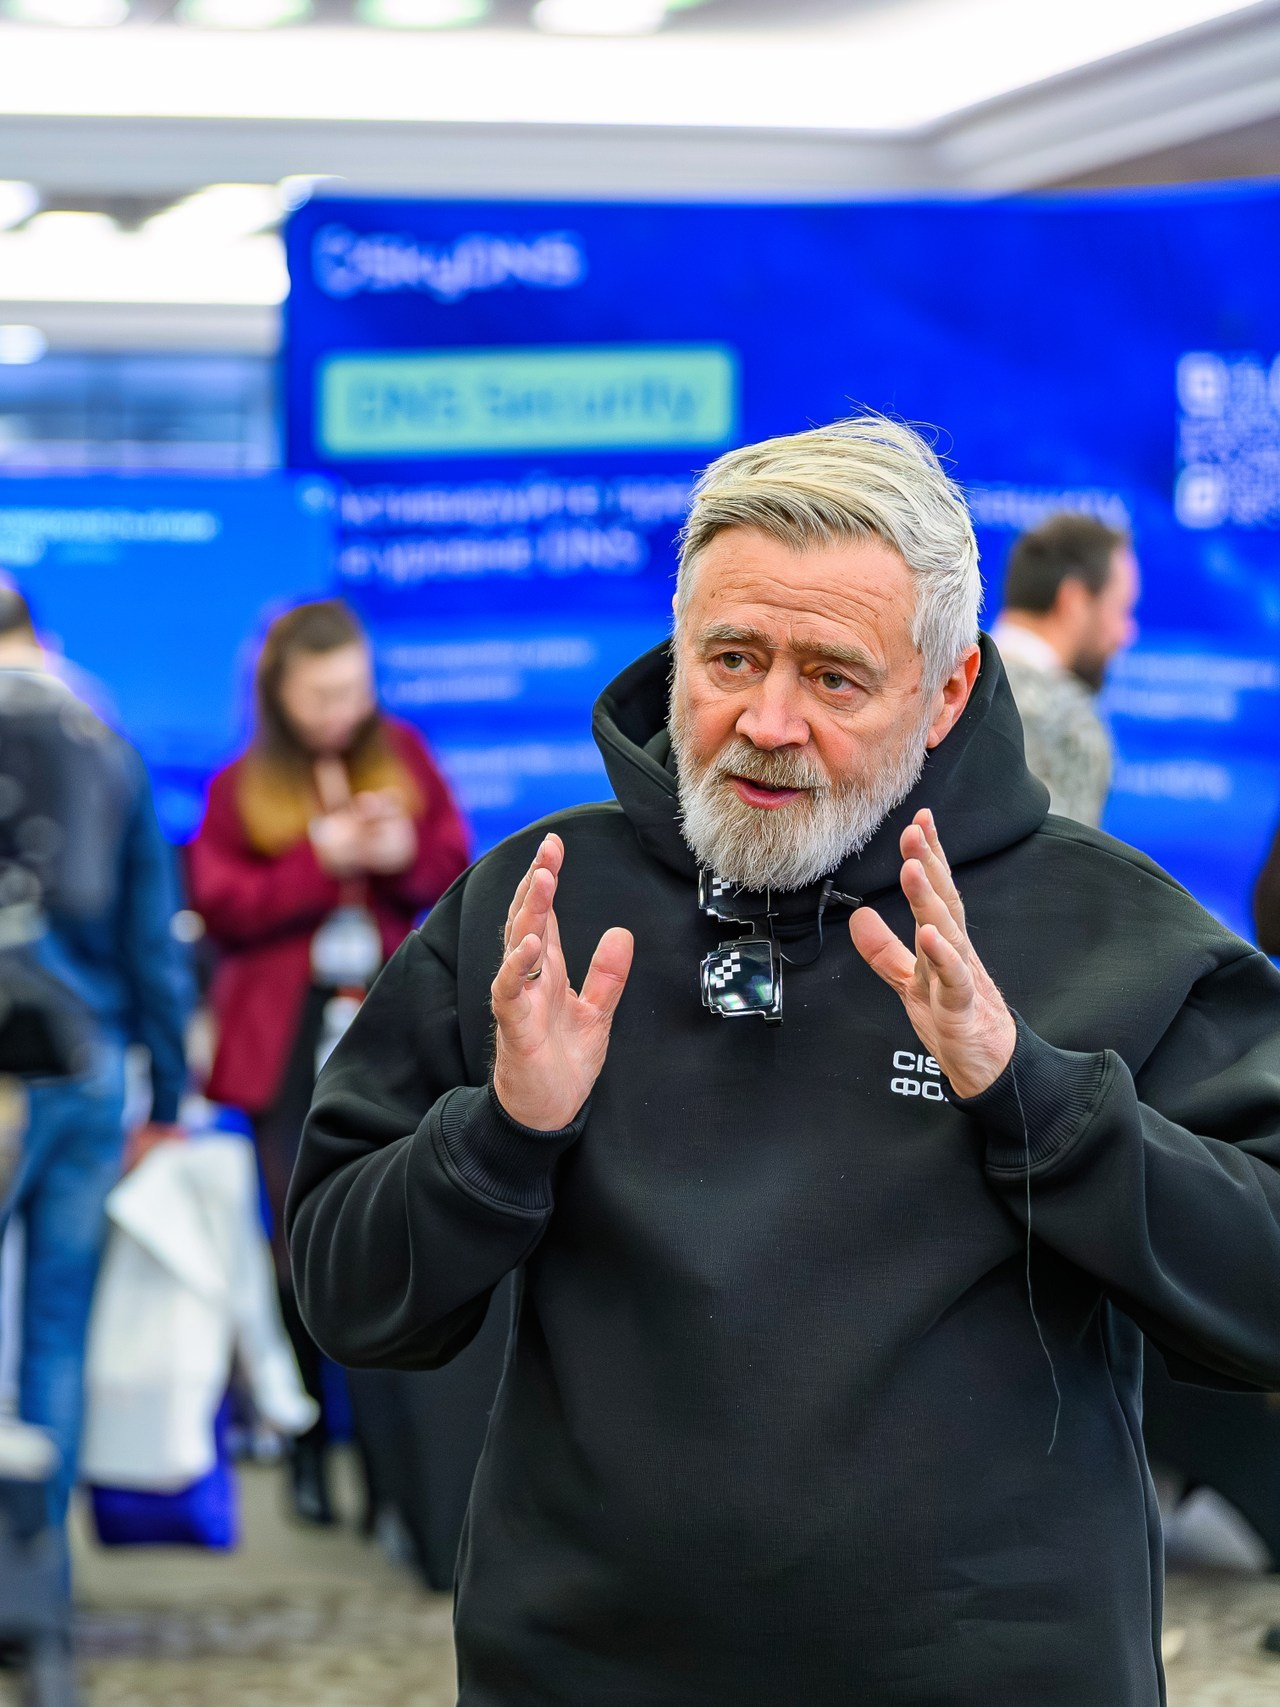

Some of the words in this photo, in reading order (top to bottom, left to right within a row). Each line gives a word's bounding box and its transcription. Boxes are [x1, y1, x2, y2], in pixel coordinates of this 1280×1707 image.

[350, 379, 463, 430] DNS
[478, 374, 699, 430] Security
[892, 1050, 941, 1076] CIS
[890, 1077, 949, 1102] ФО
